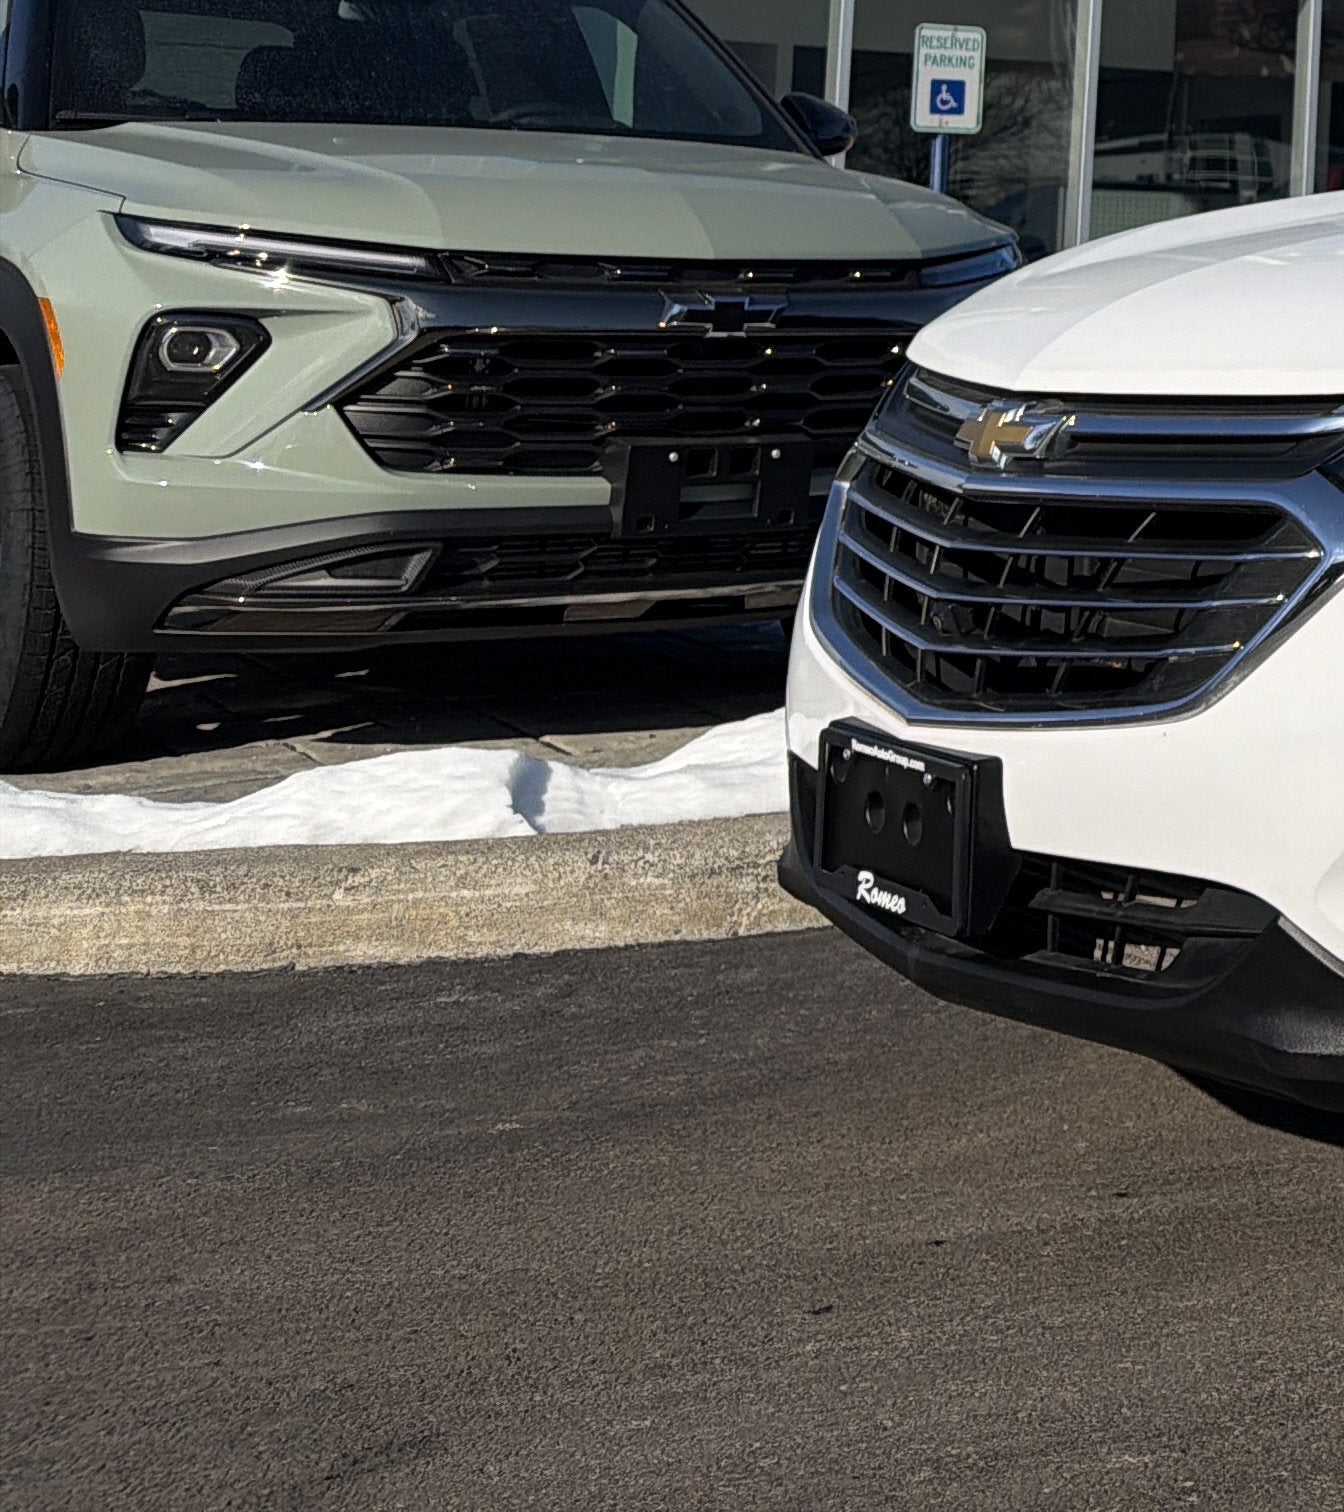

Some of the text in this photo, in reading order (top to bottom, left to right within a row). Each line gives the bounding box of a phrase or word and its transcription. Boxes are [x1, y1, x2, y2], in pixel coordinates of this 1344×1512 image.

[921, 35, 979, 51] RESERVED
[924, 53, 975, 68] PARKING
[851, 738, 925, 772] RomeoAutoGroup.com
[856, 870, 907, 915] Romeo
